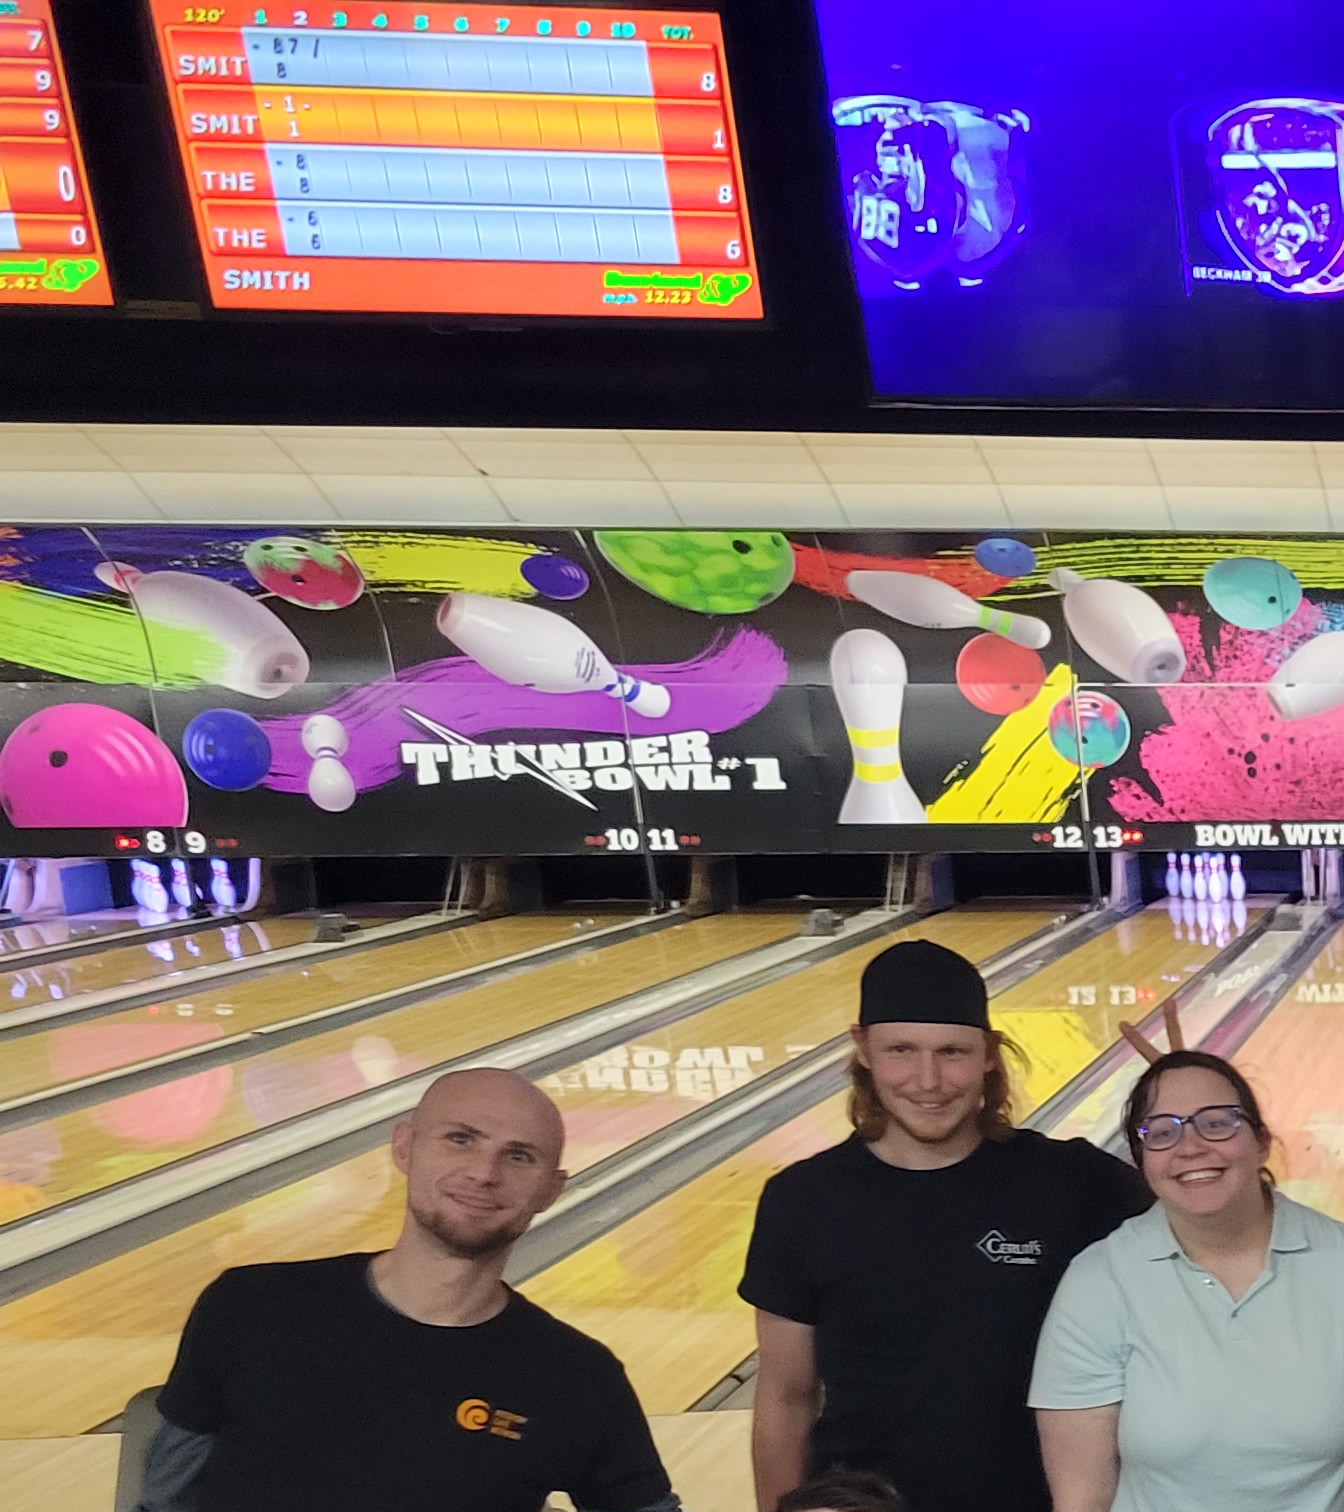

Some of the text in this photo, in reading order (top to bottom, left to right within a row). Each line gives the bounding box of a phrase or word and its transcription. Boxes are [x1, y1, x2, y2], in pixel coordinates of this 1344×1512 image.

[255, 9, 268, 26] 1
[293, 11, 308, 26] 2
[372, 13, 388, 29] 4
[27, 30, 43, 51] 7
[34, 70, 52, 91] 9
[178, 54, 248, 76] SMIT
[701, 72, 717, 92] 8
[277, 62, 287, 79] 8
[43, 109, 60, 131] 9
[190, 96, 726, 149] SMIT 1 1
[289, 120, 300, 137] 1
[58, 165, 75, 202] 0
[201, 154, 733, 204] THE 8 8
[299, 177, 310, 194] 8
[71, 226, 87, 246] 0
[213, 210, 741, 260] THE 6 6
[311, 234, 321, 250] 6
[223, 268, 311, 291] SMITH
[400, 729, 713, 786] THUNDER
[556, 763, 732, 792] BOWL
[145, 830, 206, 854] 8 9
[604, 828, 679, 851] 10 11
[1051, 827, 1124, 848] 12 13
[1195, 823, 1285, 847] BOWL
